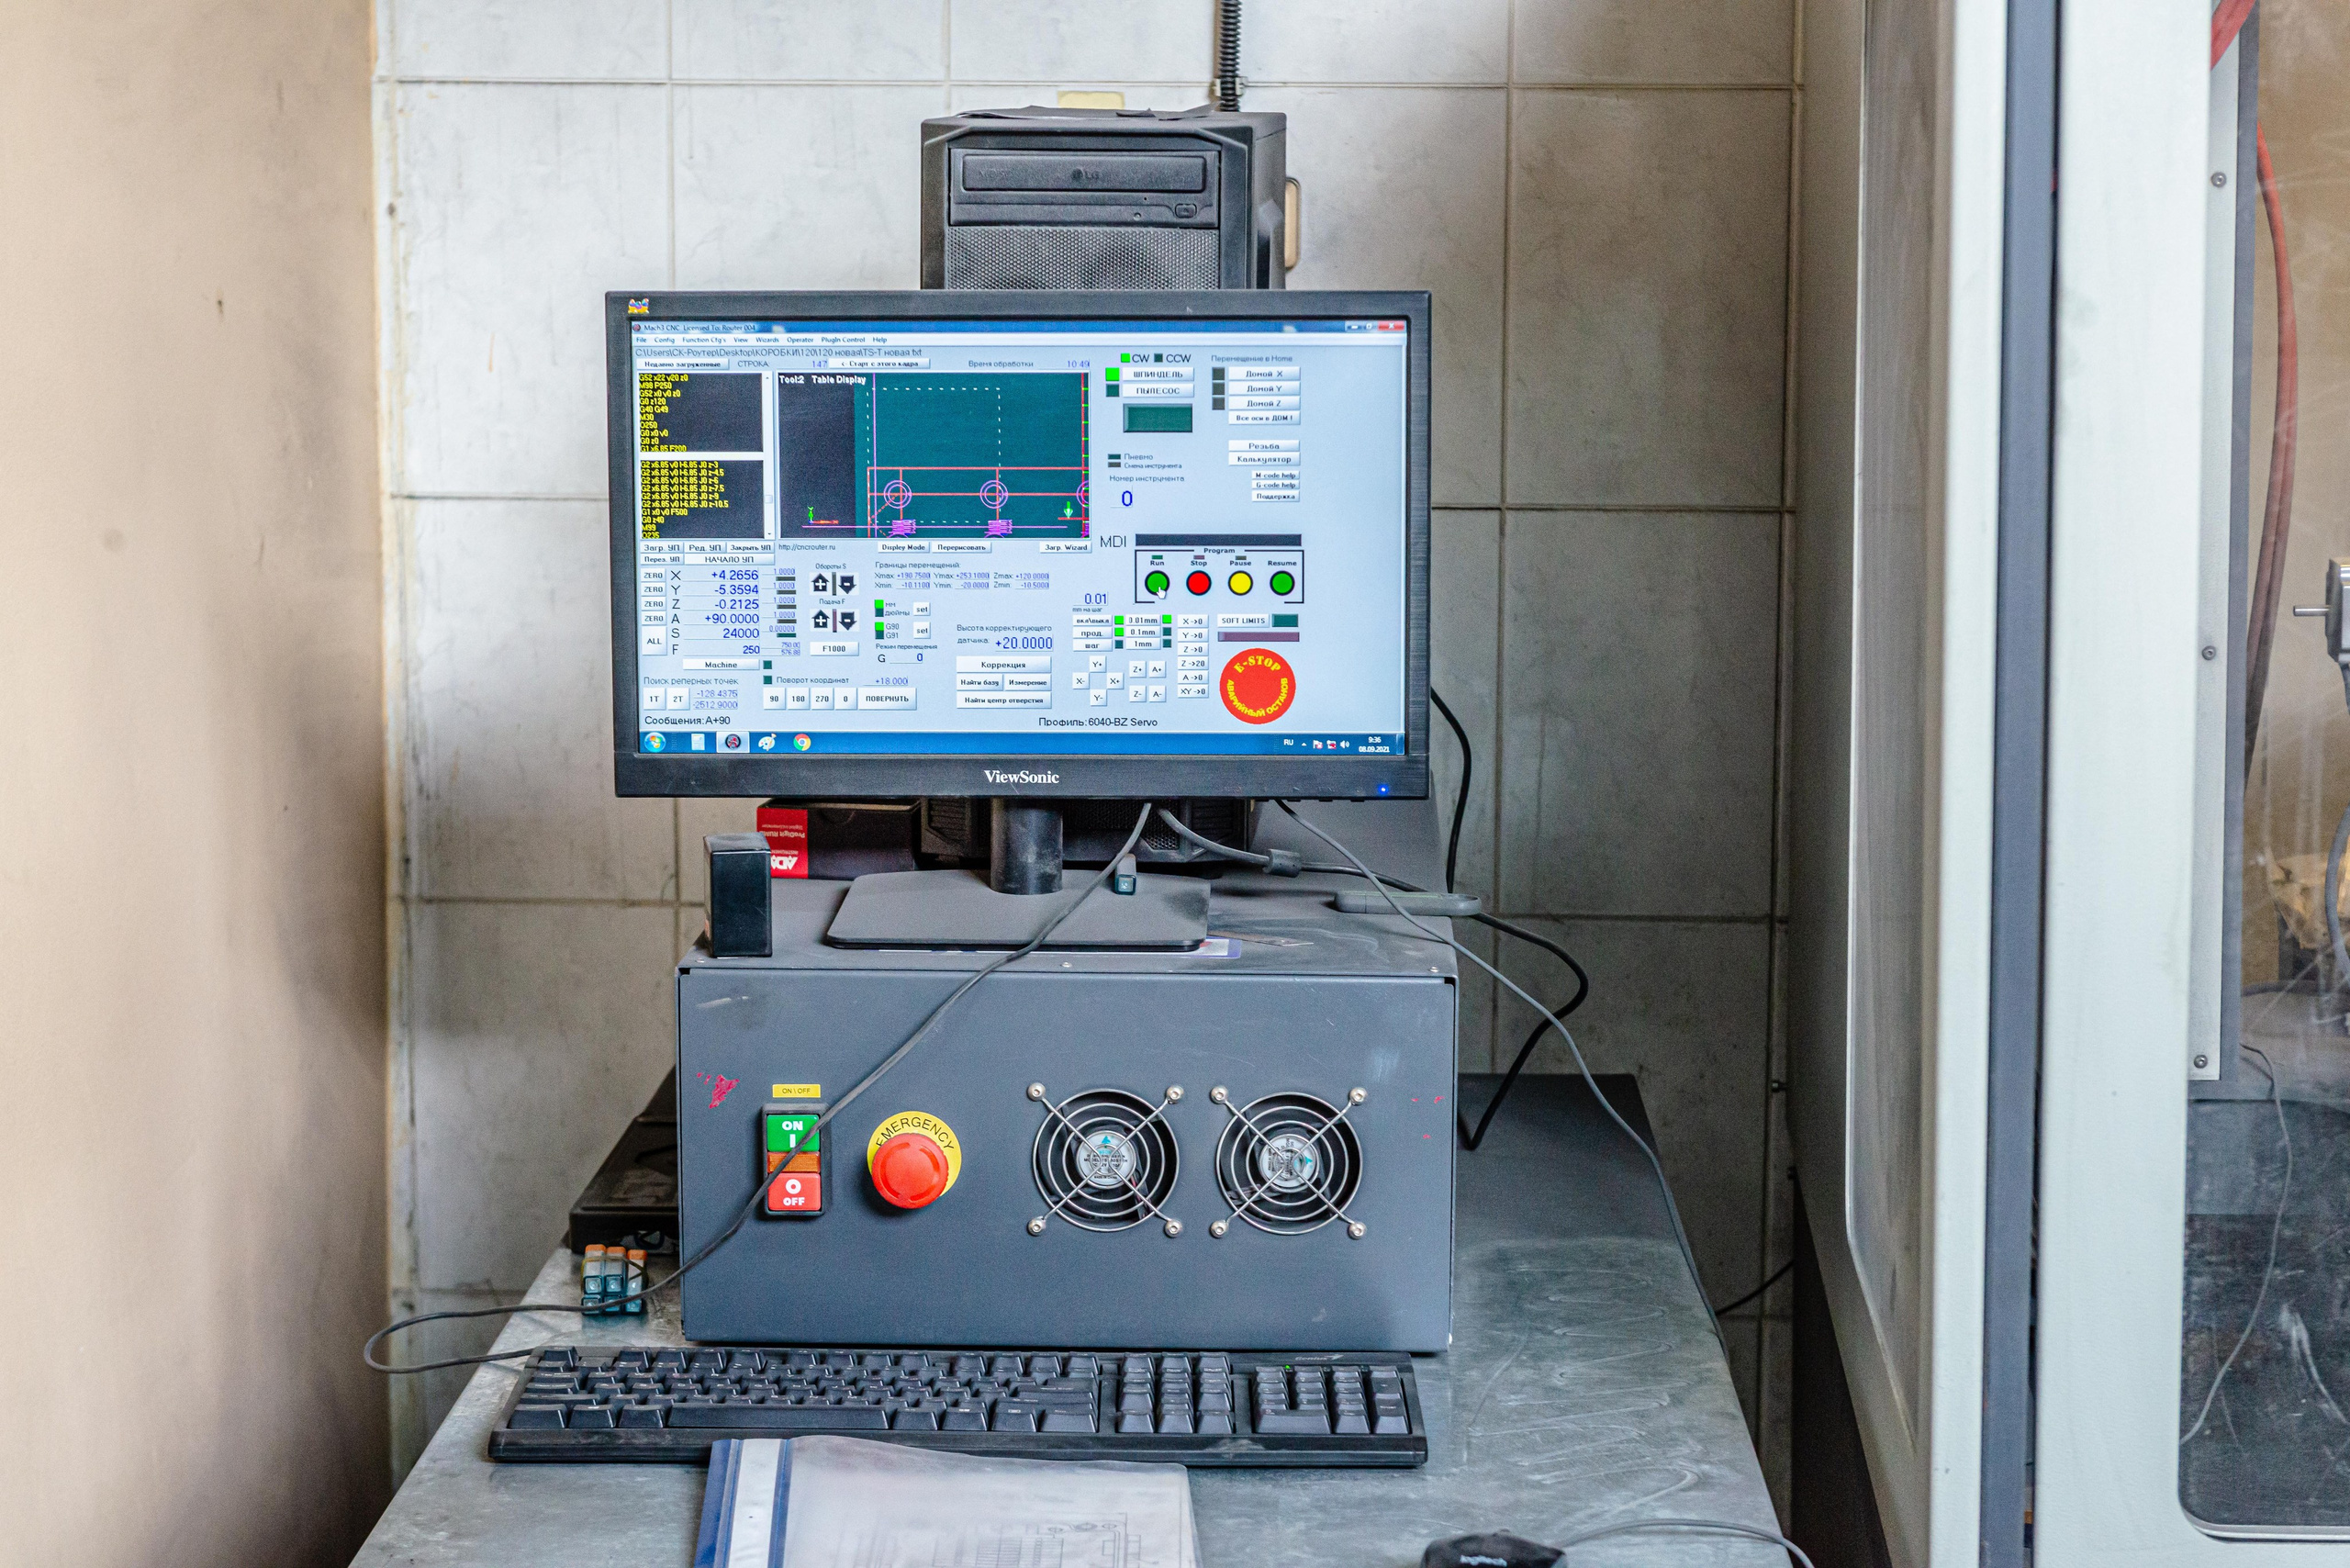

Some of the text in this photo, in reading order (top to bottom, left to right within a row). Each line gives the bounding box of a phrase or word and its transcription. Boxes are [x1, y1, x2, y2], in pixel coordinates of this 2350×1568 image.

[1132, 353, 1192, 363] CW CCW
[968, 360, 992, 368] Время
[811, 375, 834, 384] Table
[836, 375, 867, 385] Display
[1237, 455, 1292, 464] Калькулятор
[1122, 490, 1133, 507] 0
[1101, 535, 1126, 547] MDI
[671, 570, 681, 580] X
[711, 570, 758, 580] +4.2656
[671, 585, 681, 595] Y
[714, 585, 759, 595] -5.3594
[1084, 593, 1107, 604] 0.01
[672, 599, 680, 609] Z
[714, 599, 759, 610] -0.2125
[671, 613, 680, 623] A
[705, 613, 760, 624] +90.0000
[885, 622, 900, 631] G90
[671, 628, 760, 639] S 24000
[995, 636, 1053, 649] +20.0000
[672, 644, 760, 655] F 250
[878, 653, 923, 663] G 0
[981, 661, 1026, 669] Коррекция
[1233, 655, 1281, 674] E-STOP
[643, 677, 669, 685] Поиск
[671, 678, 712, 686] реперных
[810, 677, 849, 685] координат
[1226, 678, 1289, 718] АВАРИЙНЫЙ ОСТАНОВ
[1130, 717, 1158, 726] Servo
[983, 770, 1060, 784] ViewSonic
[771, 856, 799, 870] ADA
[781, 1121, 803, 1131] ON
[876, 1116, 954, 1150] EMERGENCY
[783, 1197, 805, 1206] OFF
